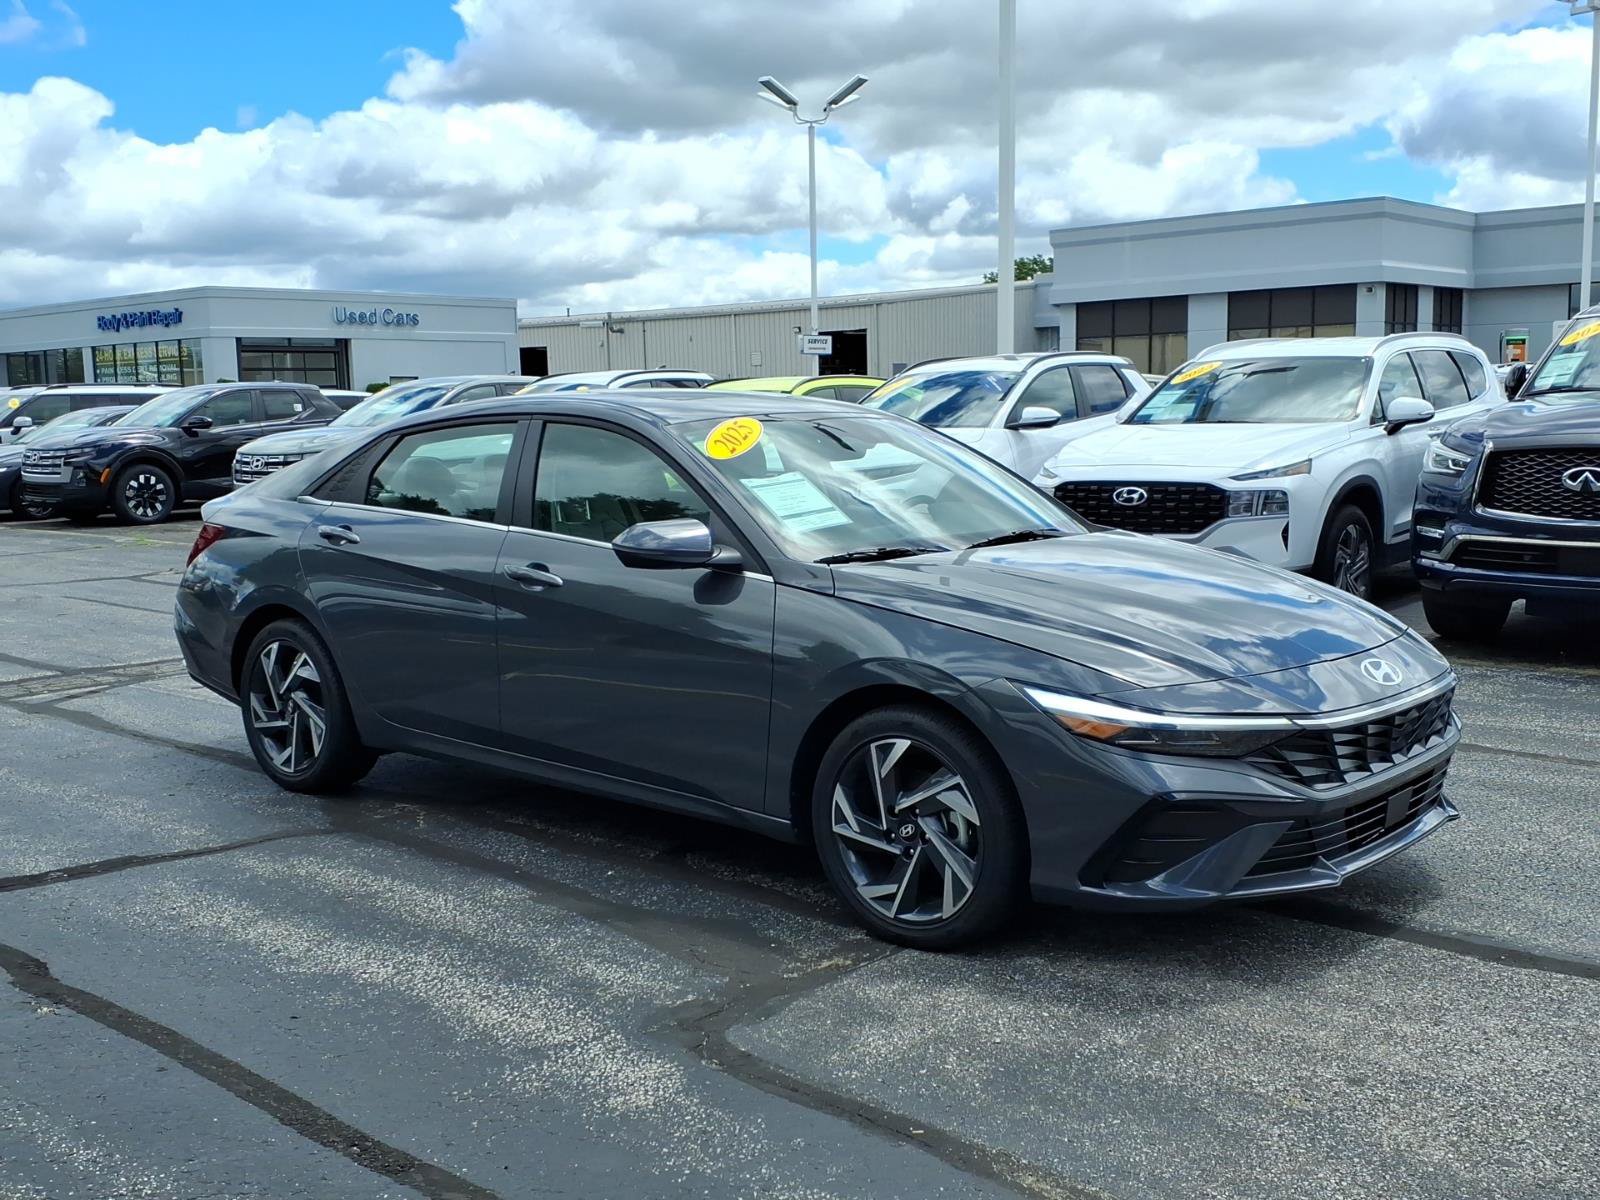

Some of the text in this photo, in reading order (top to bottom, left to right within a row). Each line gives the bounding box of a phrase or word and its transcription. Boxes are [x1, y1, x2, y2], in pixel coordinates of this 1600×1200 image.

[97, 314, 121, 332] Body
[152, 307, 183, 327] Repair
[334, 306, 420, 326] Used Cars
[713, 420, 754, 455] 2025
